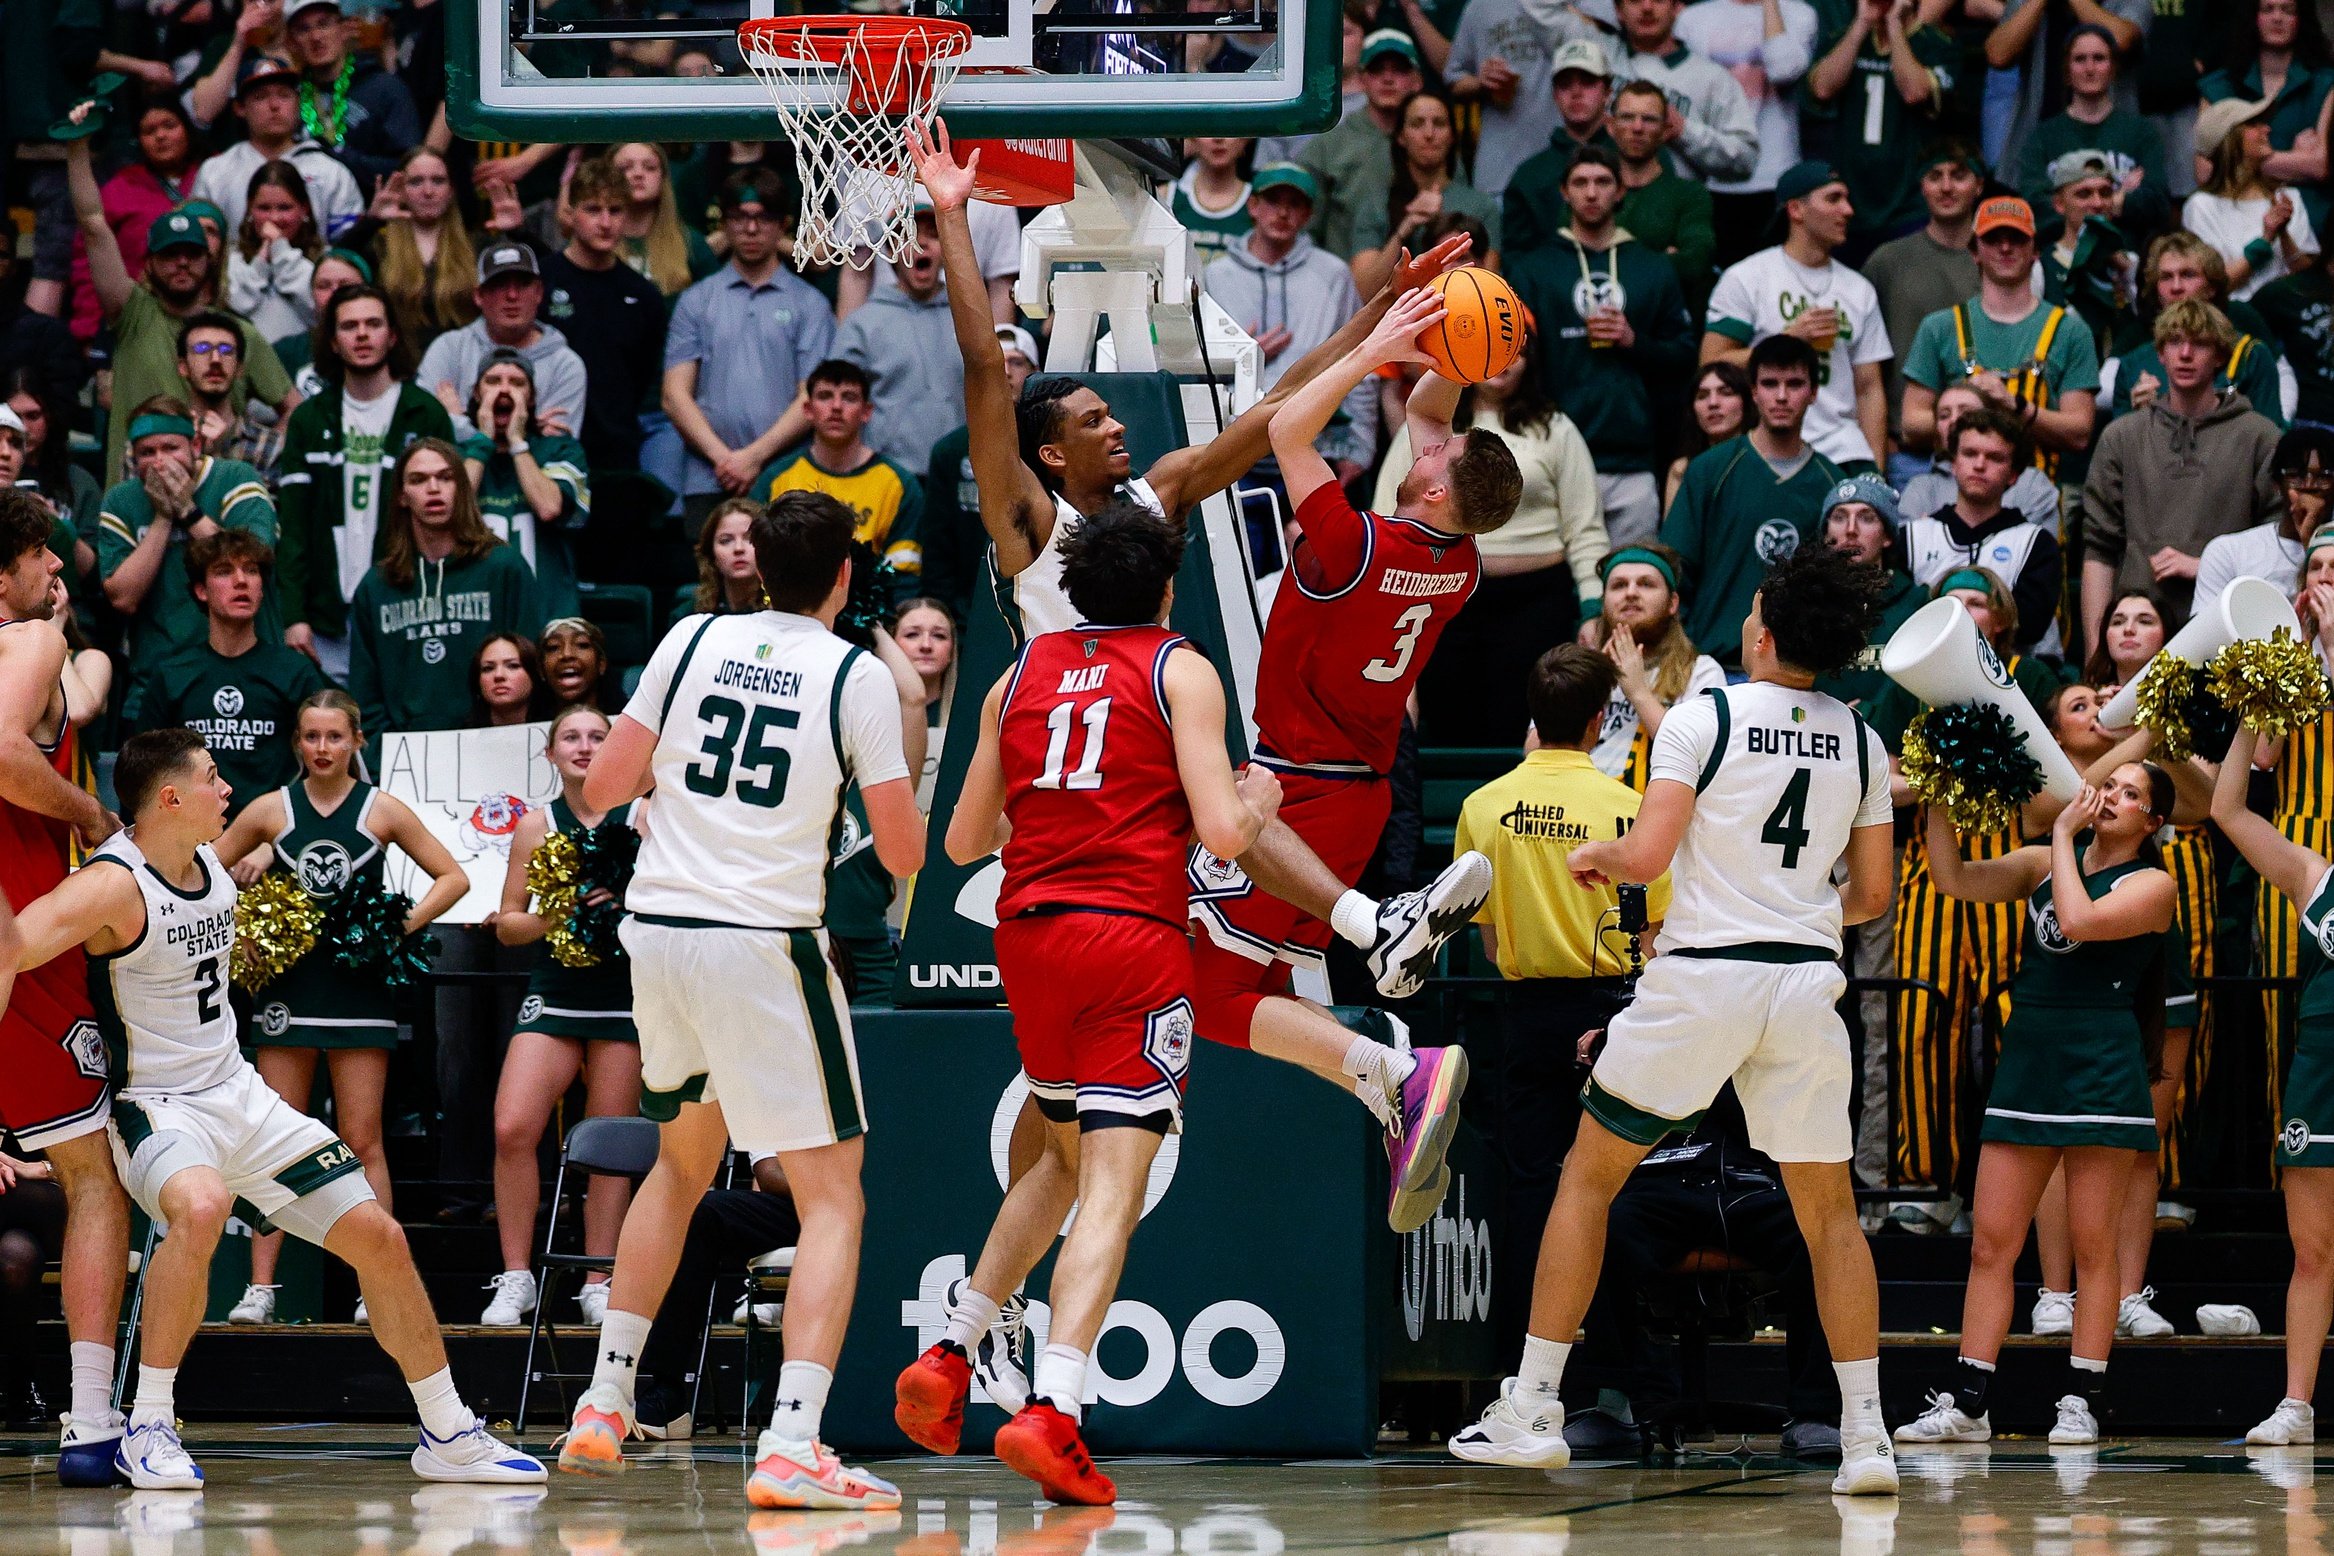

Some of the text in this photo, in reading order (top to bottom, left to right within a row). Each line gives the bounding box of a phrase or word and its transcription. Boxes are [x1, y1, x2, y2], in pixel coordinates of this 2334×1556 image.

[1495, 296, 1513, 343] EVO
[1378, 567, 1469, 597] HEIDBREDER
[446, 591, 491, 621] STATE
[406, 621, 462, 641] RAMS
[1361, 603, 1433, 682] 3
[714, 658, 803, 698] JORGENSEN
[1055, 663, 1111, 695] MANI
[203, 733, 256, 751] STATE
[685, 694, 801, 808] 35
[1031, 696, 1113, 790] 11
[1748, 726, 1841, 761] BUTLER
[386, 732, 478, 804] ALL
[1514, 800, 1565, 821] ALLIED
[1760, 767, 1812, 870] 4
[1513, 815, 1590, 840] UNIVERSAL
[187, 929, 229, 957] STATE
[193, 956, 221, 1026] 2
[909, 963, 1005, 988] UND
